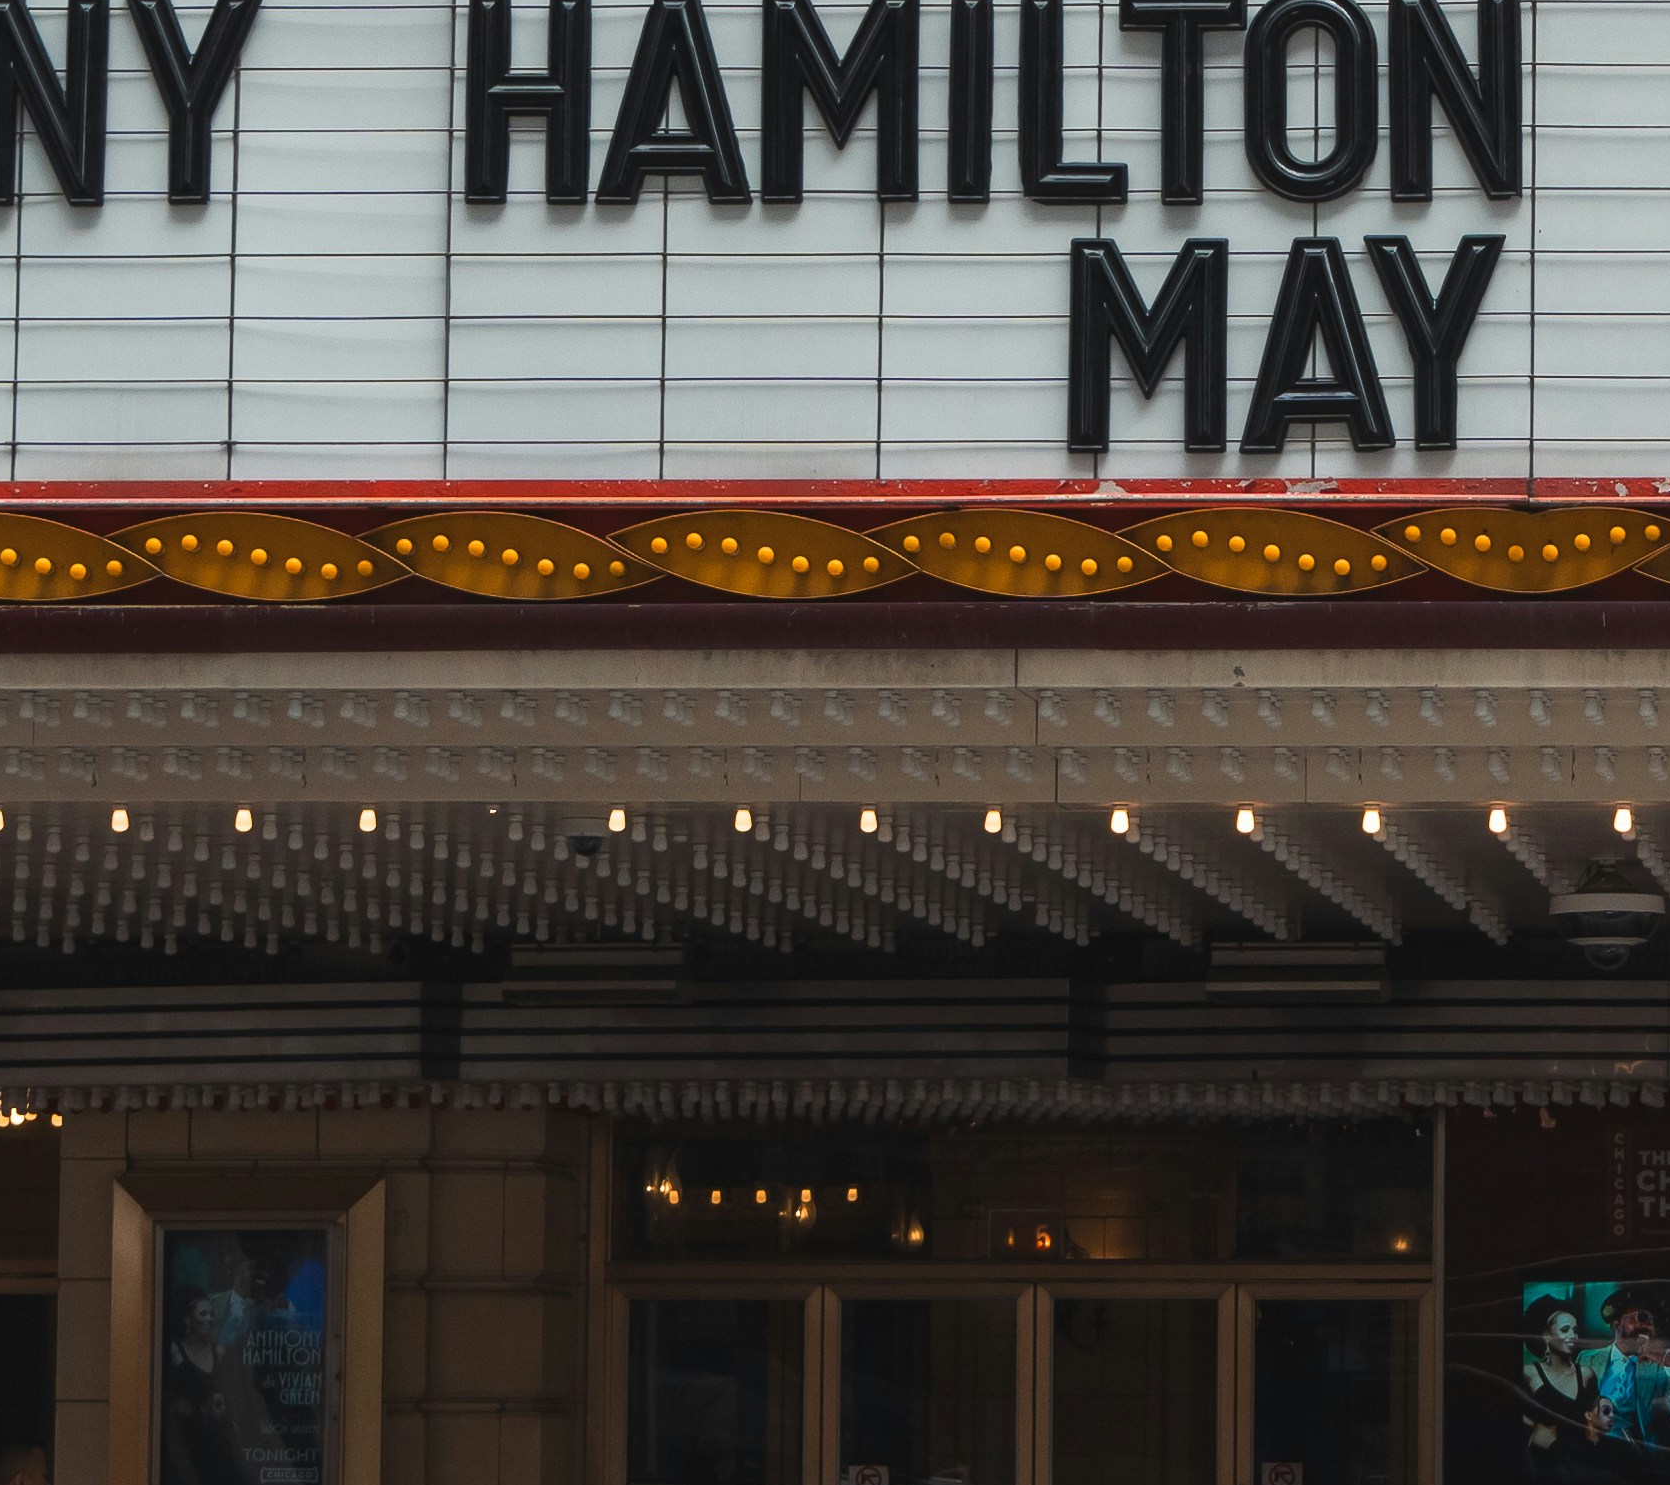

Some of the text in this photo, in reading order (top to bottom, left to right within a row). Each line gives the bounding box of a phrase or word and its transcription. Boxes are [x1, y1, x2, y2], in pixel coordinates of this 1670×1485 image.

[1067, 233, 1506, 455] MAY
[1612, 1132, 1626, 1236] CHICAGO
[246, 1330, 321, 1347] ANTHONY
[242, 1347, 321, 1365] HAMILTON
[279, 1372, 322, 1389] VIVIAN
[279, 1388, 321, 1405] GREEN
[242, 1448, 318, 1461] TONIGHT
